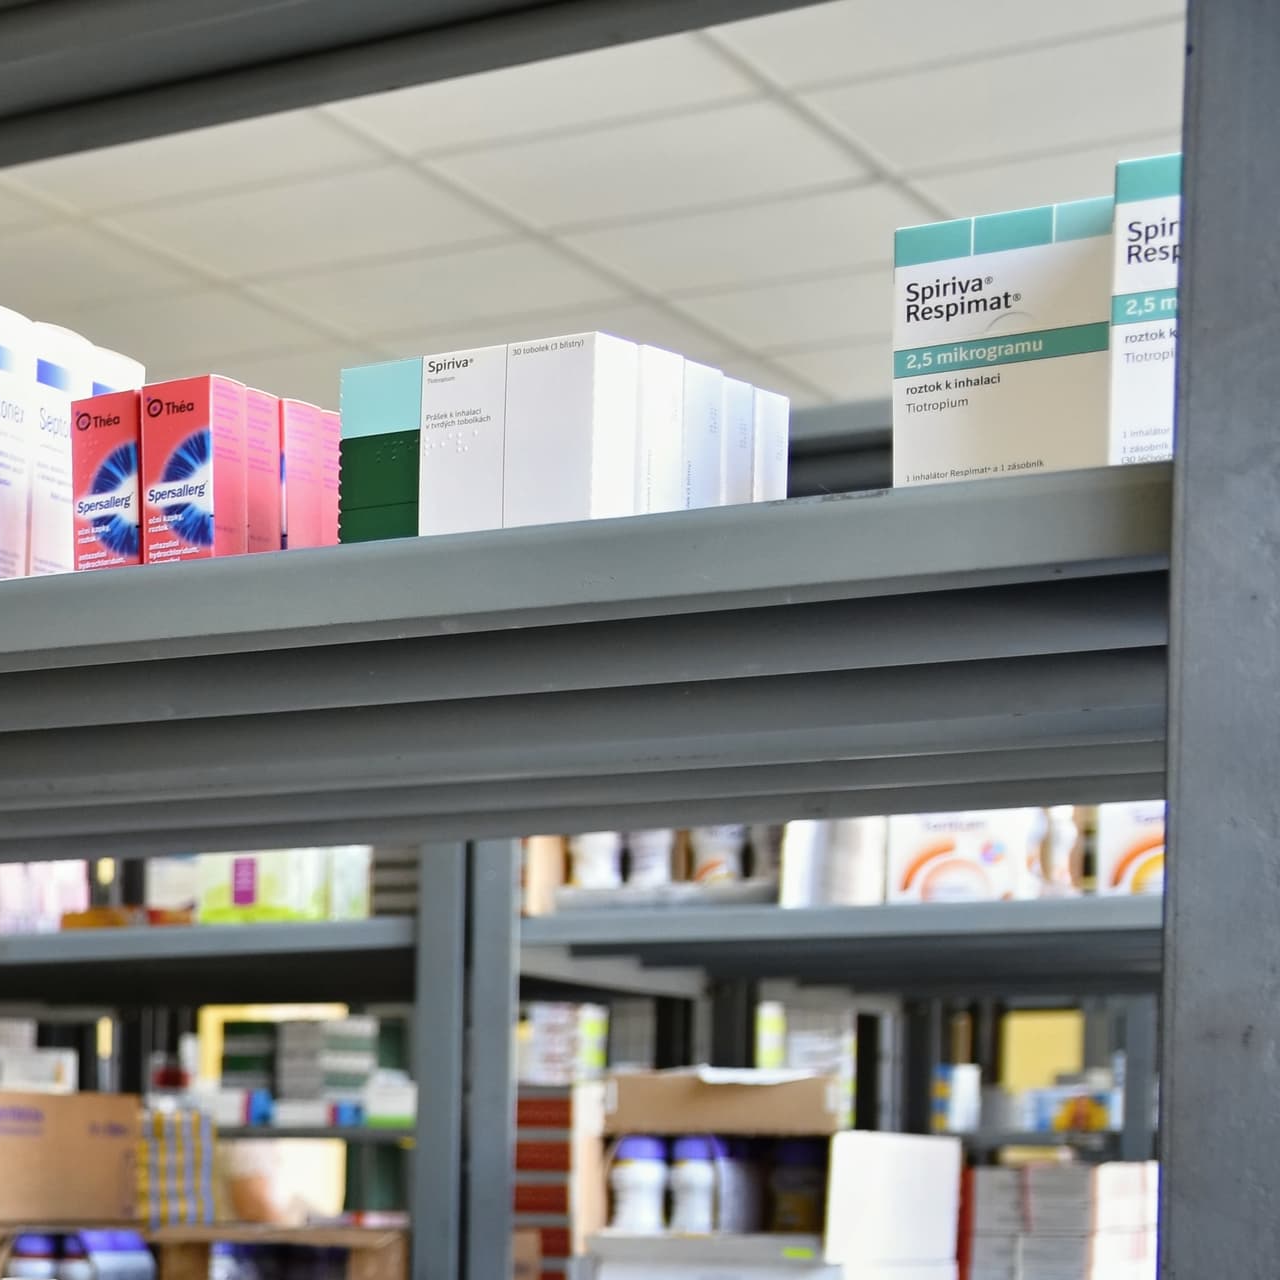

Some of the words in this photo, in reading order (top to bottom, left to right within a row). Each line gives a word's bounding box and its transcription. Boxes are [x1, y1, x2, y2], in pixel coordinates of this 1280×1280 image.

[1127, 217, 1180, 244] Spir
[1126, 244, 1180, 265] Resp
[906, 351, 932, 369] 2,5
[937, 338, 1043, 365] mikrogramu
[1125, 351, 1174, 364] Tiotropi
[906, 380, 943, 396] roztok
[945, 378, 952, 390] k
[954, 373, 1001, 389] inhalaci
[166, 400, 194, 415] Théa
[906, 397, 969, 414] Tiotropium
[93, 414, 120, 429] Théa
[148, 482, 207, 503] Spersallerg
[78, 493, 133, 514] Spersallerg
